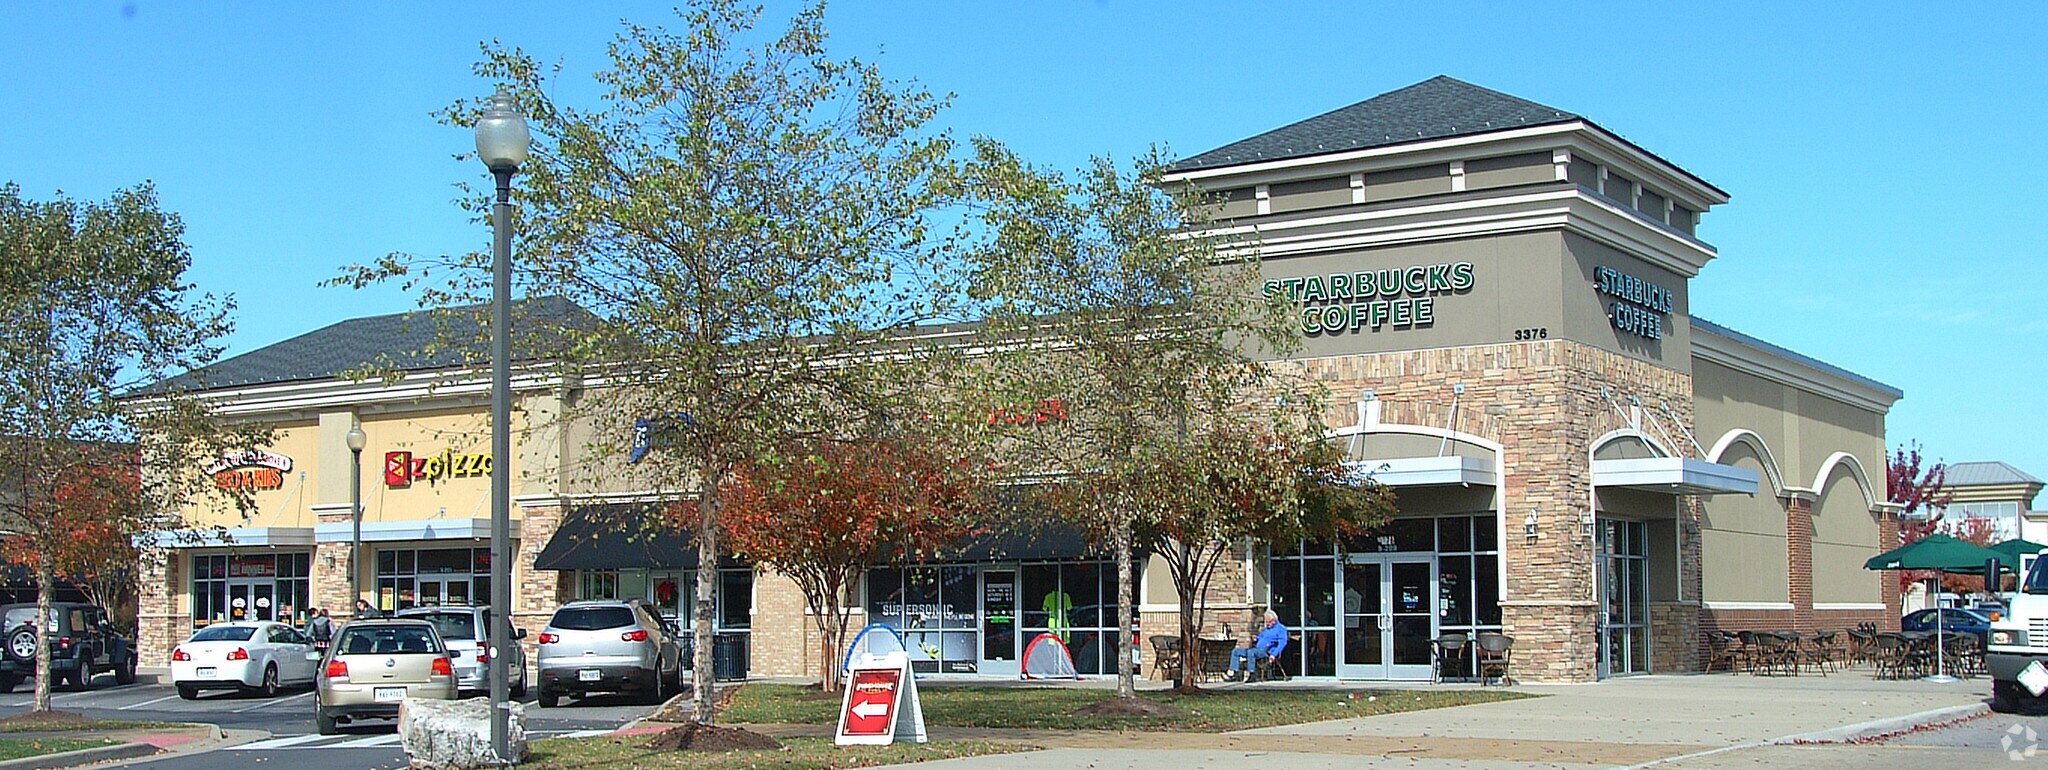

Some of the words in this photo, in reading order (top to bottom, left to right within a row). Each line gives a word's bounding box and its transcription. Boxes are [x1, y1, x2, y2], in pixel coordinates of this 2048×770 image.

[1262, 261, 1474, 304] STARBUCKS
[1600, 265, 1674, 316] STARBUCKS
[1301, 297, 1434, 334] COFFEE
[1514, 327, 1548, 341] 3376
[1615, 301, 1662, 341] COFFEE
[882, 603, 954, 617] SUPERSONIC
